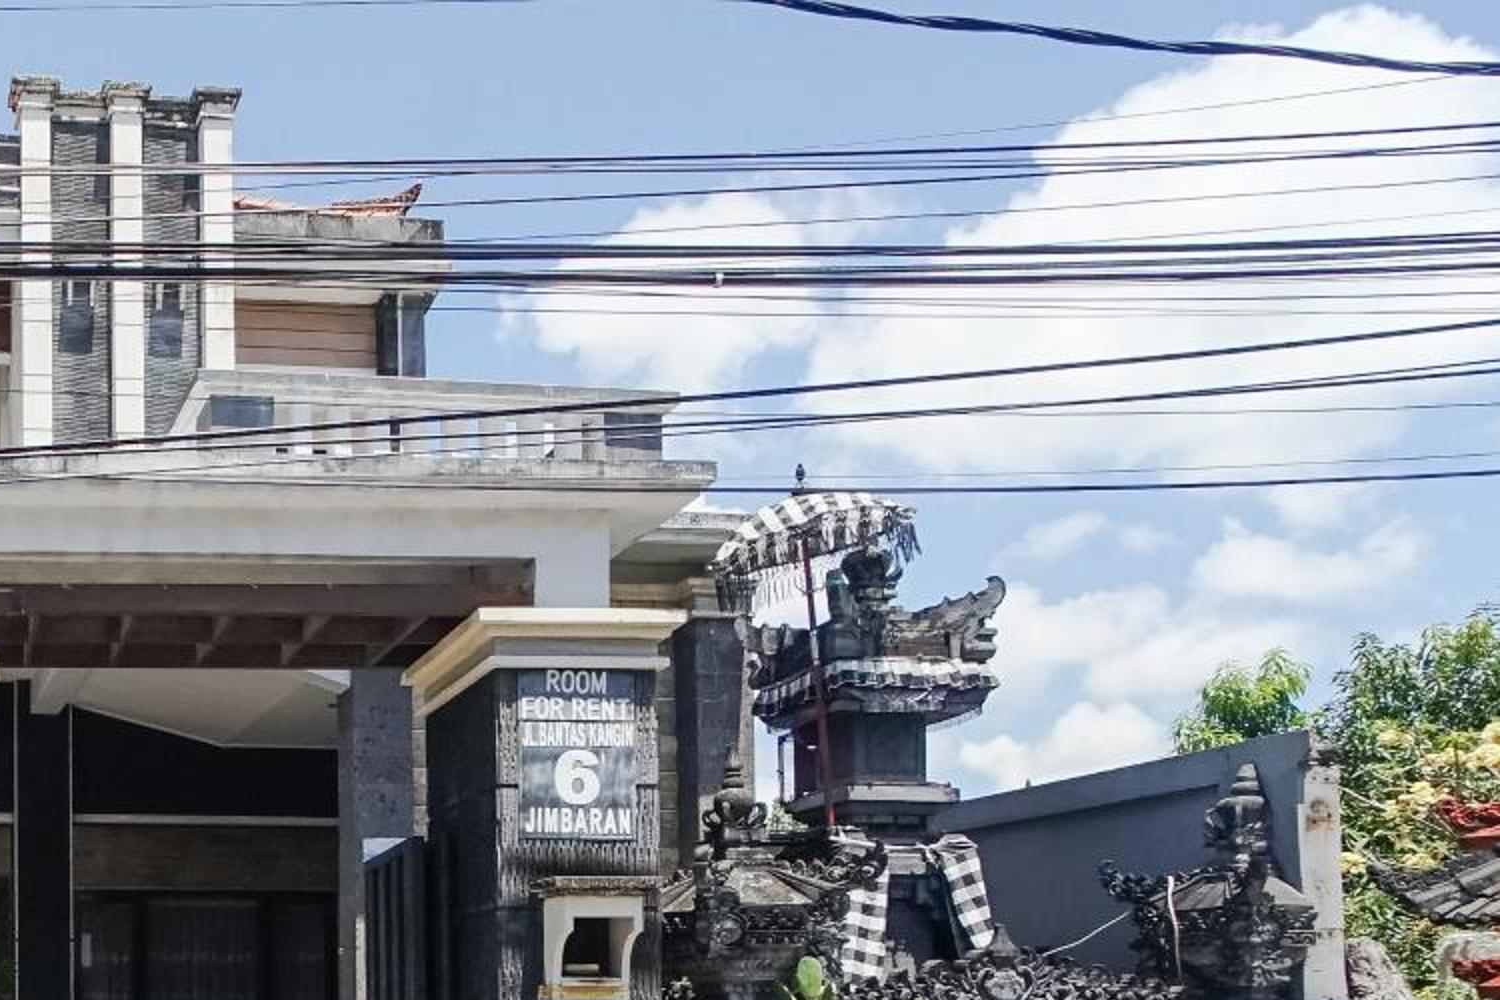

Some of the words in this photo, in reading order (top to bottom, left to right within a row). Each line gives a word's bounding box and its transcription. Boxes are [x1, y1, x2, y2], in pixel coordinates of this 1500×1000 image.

[546, 669, 607, 694] ROOM
[521, 697, 565, 719] FOR
[572, 697, 630, 719] RENT
[554, 749, 601, 805] 6
[525, 807, 631, 834] JIMBARAN
